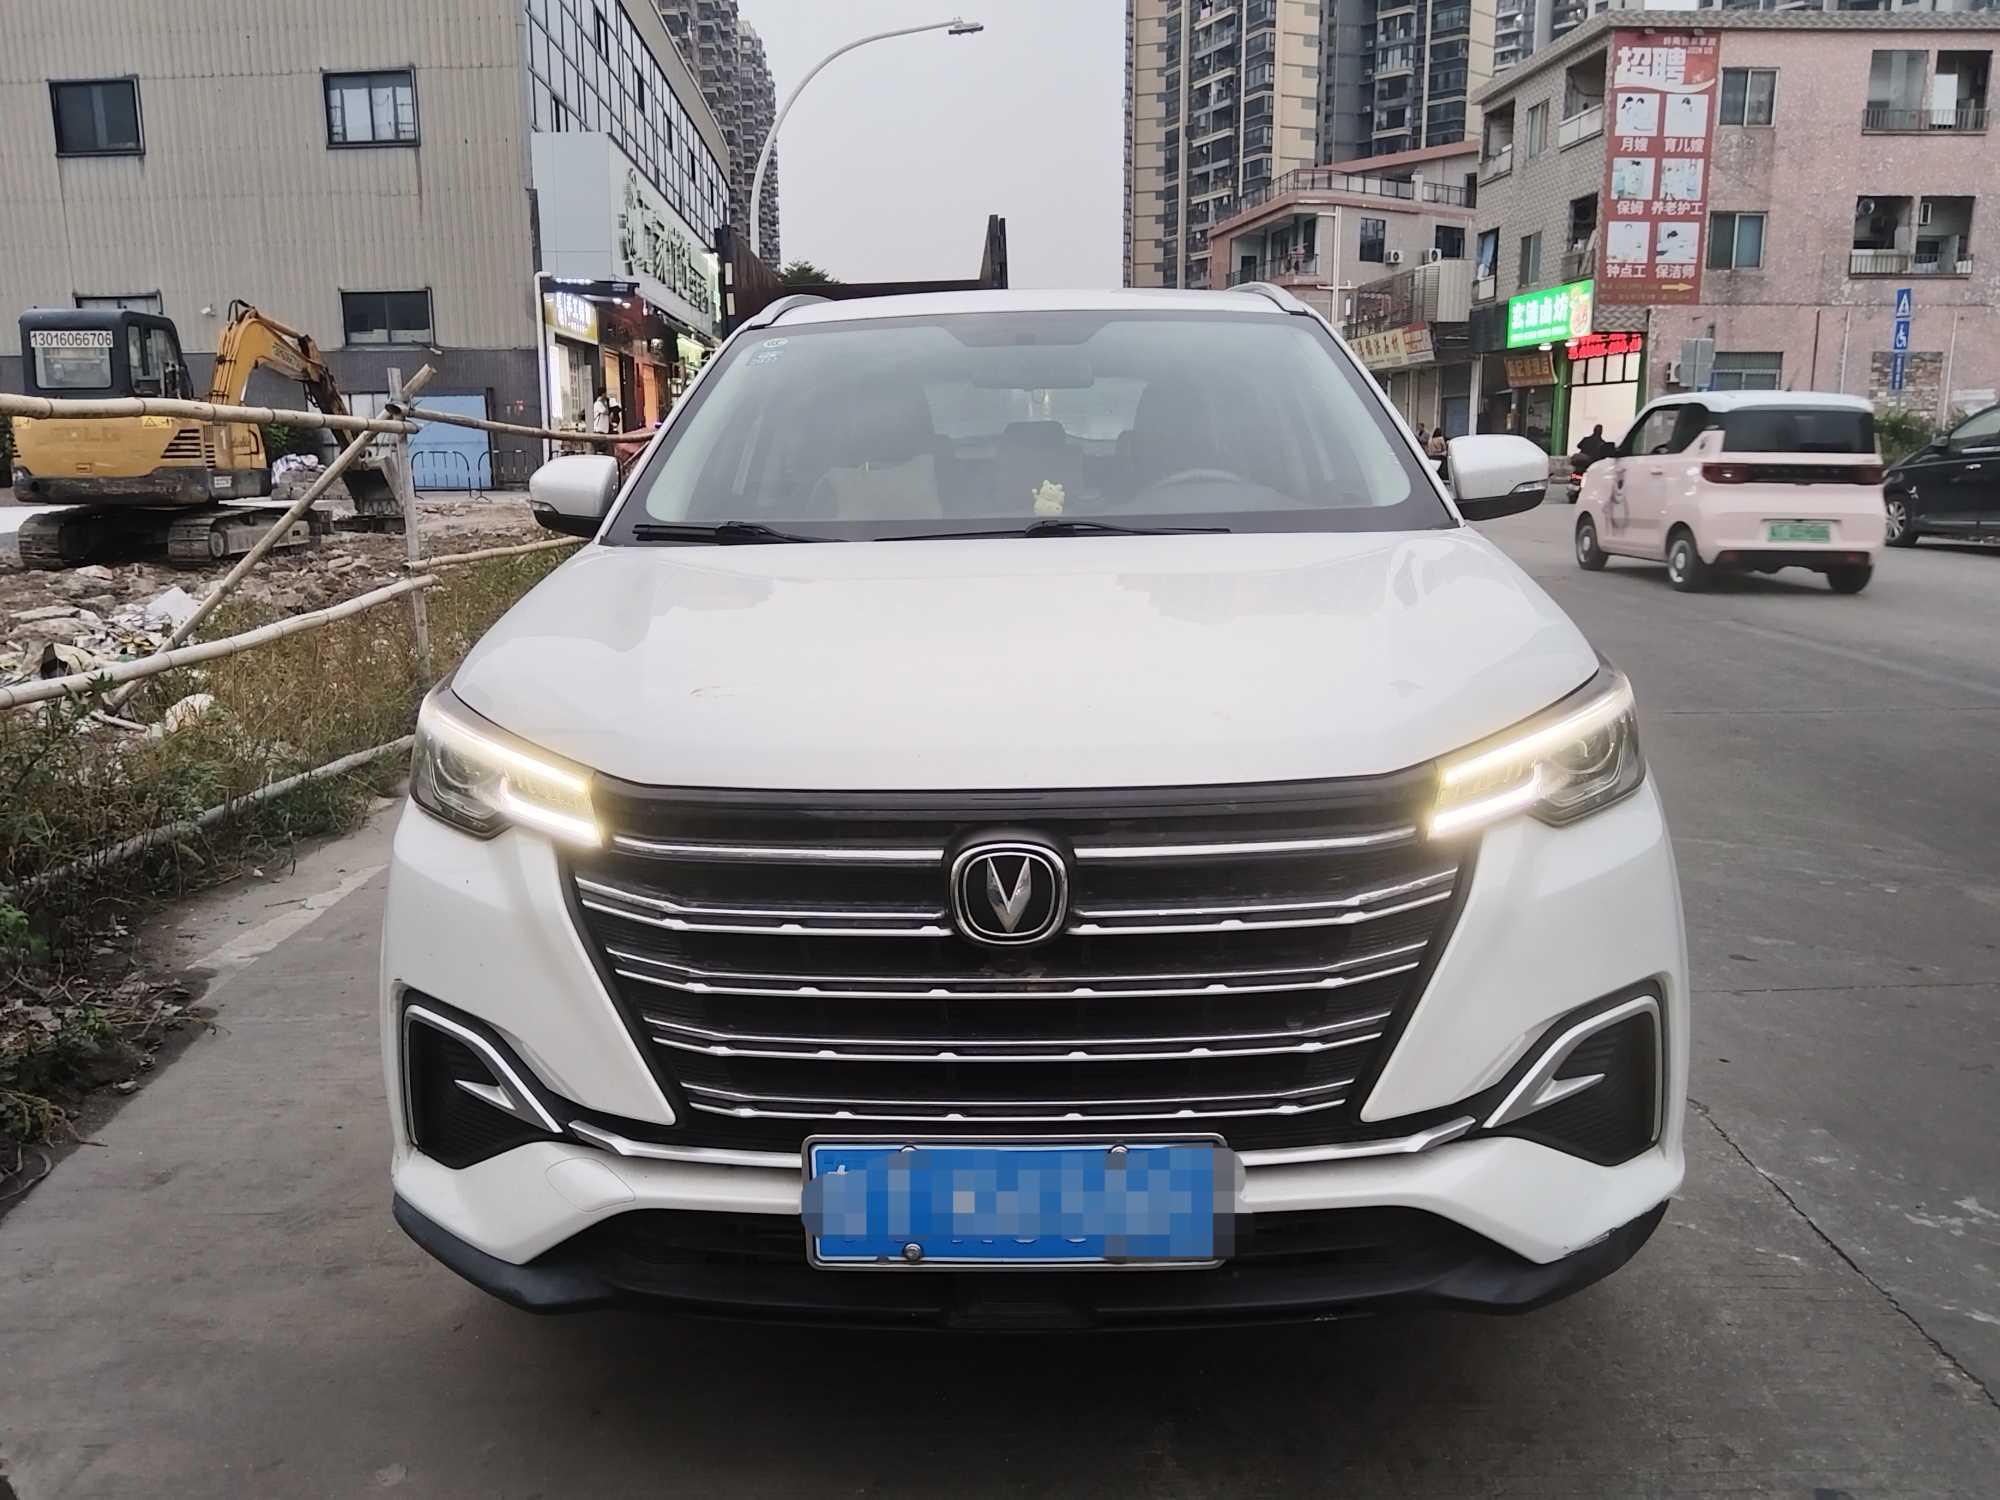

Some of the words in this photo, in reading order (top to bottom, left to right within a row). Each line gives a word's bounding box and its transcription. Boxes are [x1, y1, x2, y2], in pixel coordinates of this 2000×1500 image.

[1615, 46, 1686, 86] 招聘
[1620, 137, 1648, 152] 月嫂
[1665, 138, 1705, 152] 育儿嫂
[1617, 201, 1644, 216] 保姆
[1651, 201, 1703, 216] 养老护工
[1607, 264, 1647, 278] 钟点工
[1656, 264, 1696, 279] 保洁师
[31, 332, 112, 346] 13016066706
